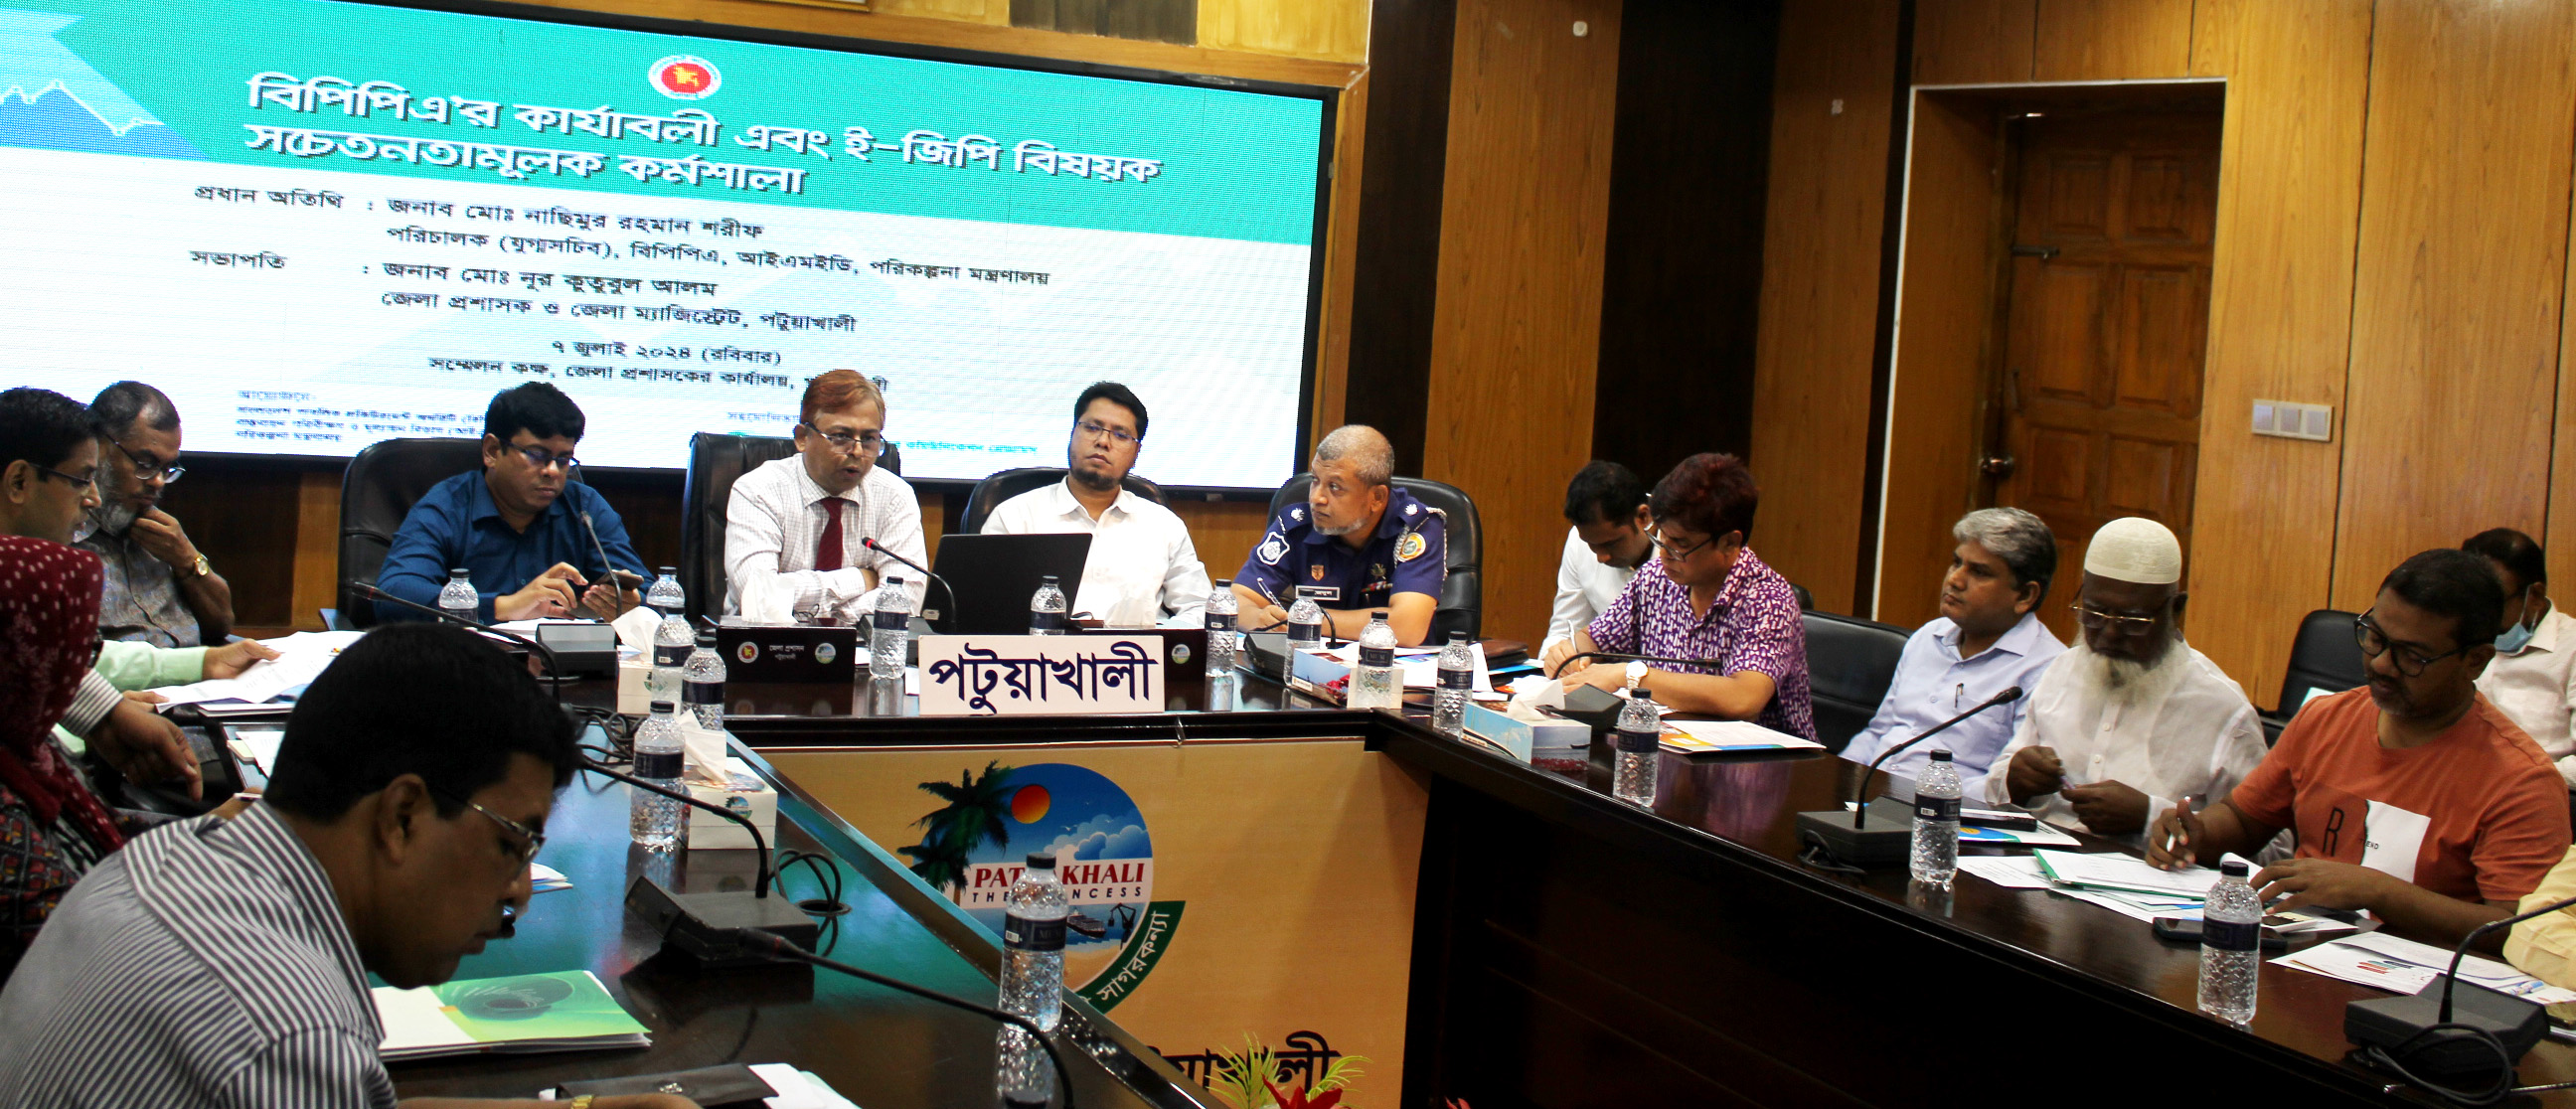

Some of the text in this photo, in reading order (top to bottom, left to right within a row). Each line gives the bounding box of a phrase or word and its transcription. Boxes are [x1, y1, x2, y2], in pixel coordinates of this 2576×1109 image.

[243, 124, 809, 195] সচেতনতামূলক কর্মশালা
[513, 104, 722, 147] কার্যাবলী
[734, 125, 833, 161] এবং
[1012, 139, 1164, 184] বিষয়ক
[195, 186, 260, 204] প্রধান
[266, 188, 345, 209] অতিথি
[387, 198, 456, 217] জনাব
[466, 205, 515, 222] মোঃ
[617, 214, 693, 235] রহমান
[701, 217, 765, 238] শরীফ
[189, 250, 287, 269] সভাপতি
[383, 262, 451, 280] জনাব
[461, 268, 510, 285] মোঃ
[651, 279, 719, 296] আলম
[387, 225, 490, 246] পরিচালক
[871, 258, 960, 279] পরিকল্পনা
[968, 267, 1050, 286] মন্ত্রণালয়
[382, 291, 440, 309] জেলা
[448, 295, 534, 314] প্রশাসক
[543, 302, 560, 315] ও
[570, 303, 626, 319] জেলা
[759, 309, 858, 332] পটুয়াখালী
[552, 340, 564, 354] ৭
[571, 340, 628, 358] জুলাই
[636, 345, 691, 359] ২০২৪
[565, 365, 613, 379] জেলা
[621, 367, 714, 384] প্রশাসকের
[928, 641, 1159, 715] পটুয়াখালী
[974, 863, 1145, 888] PATKHALI
[1096, 910, 1171, 1001] সাগরকন্যা
